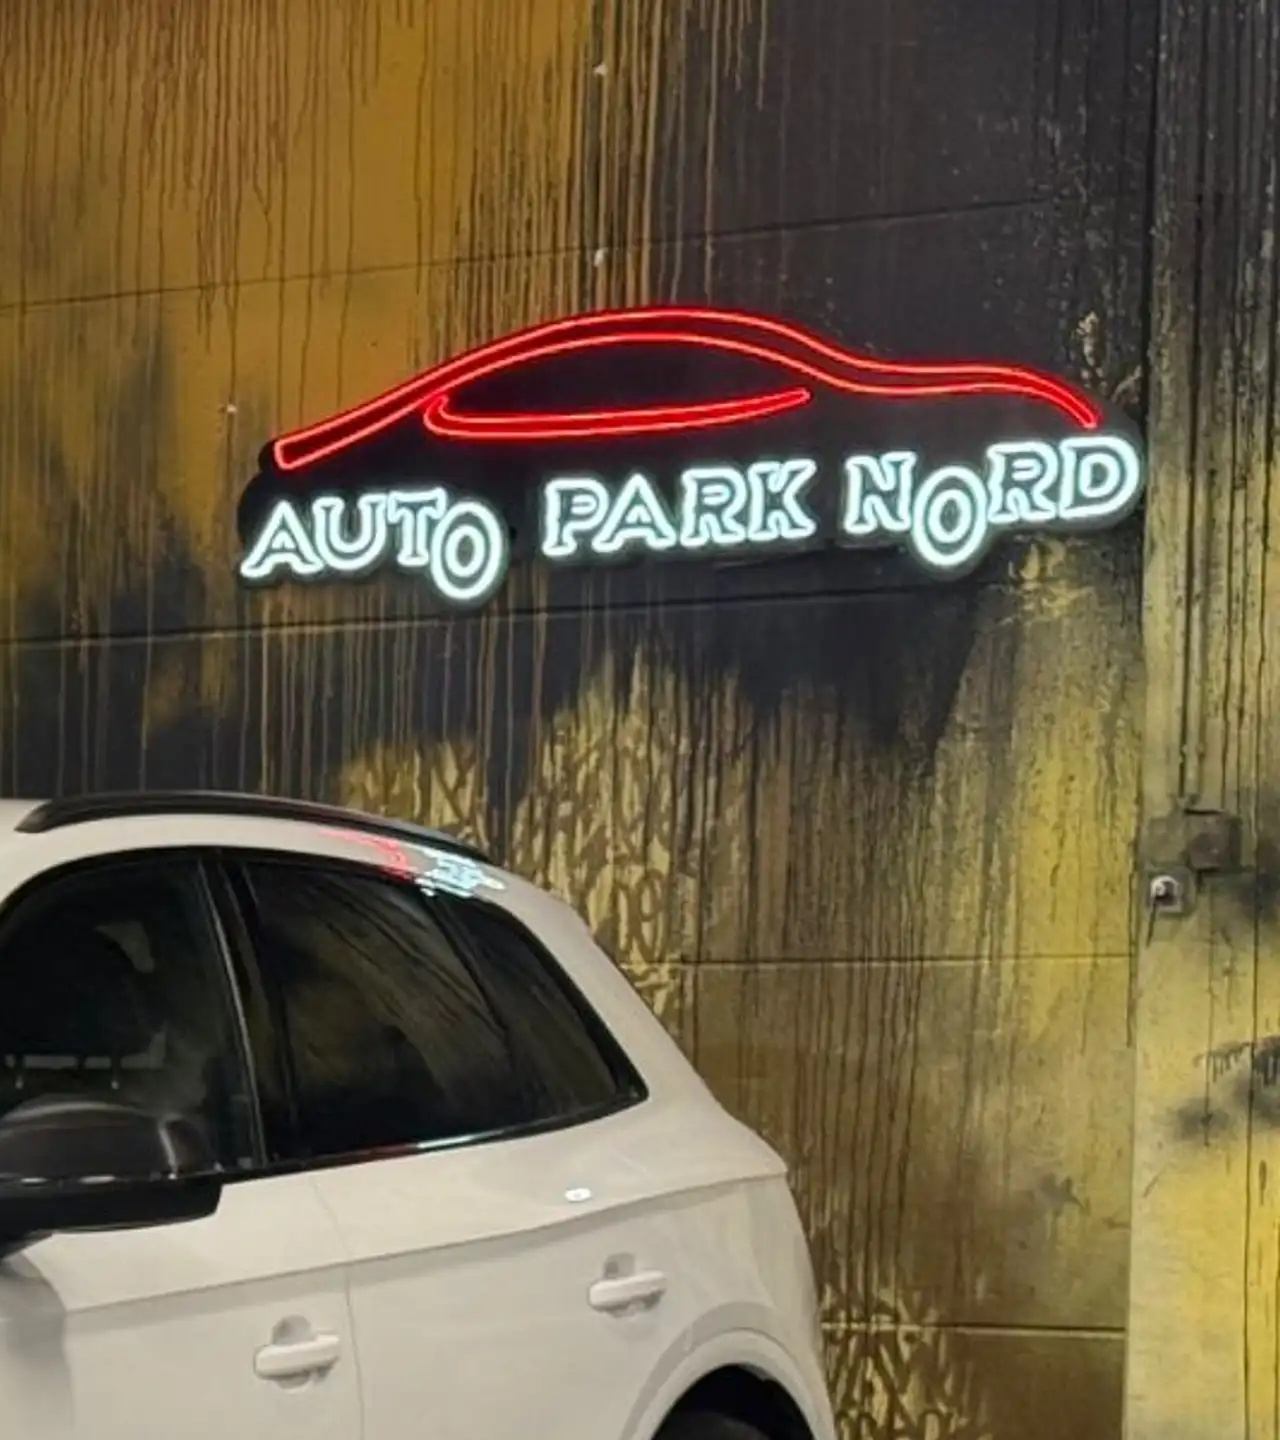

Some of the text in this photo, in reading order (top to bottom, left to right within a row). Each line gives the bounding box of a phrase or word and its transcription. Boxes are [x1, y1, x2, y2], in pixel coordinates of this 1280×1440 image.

[241, 434, 1142, 601] AUTO PARK NORD
